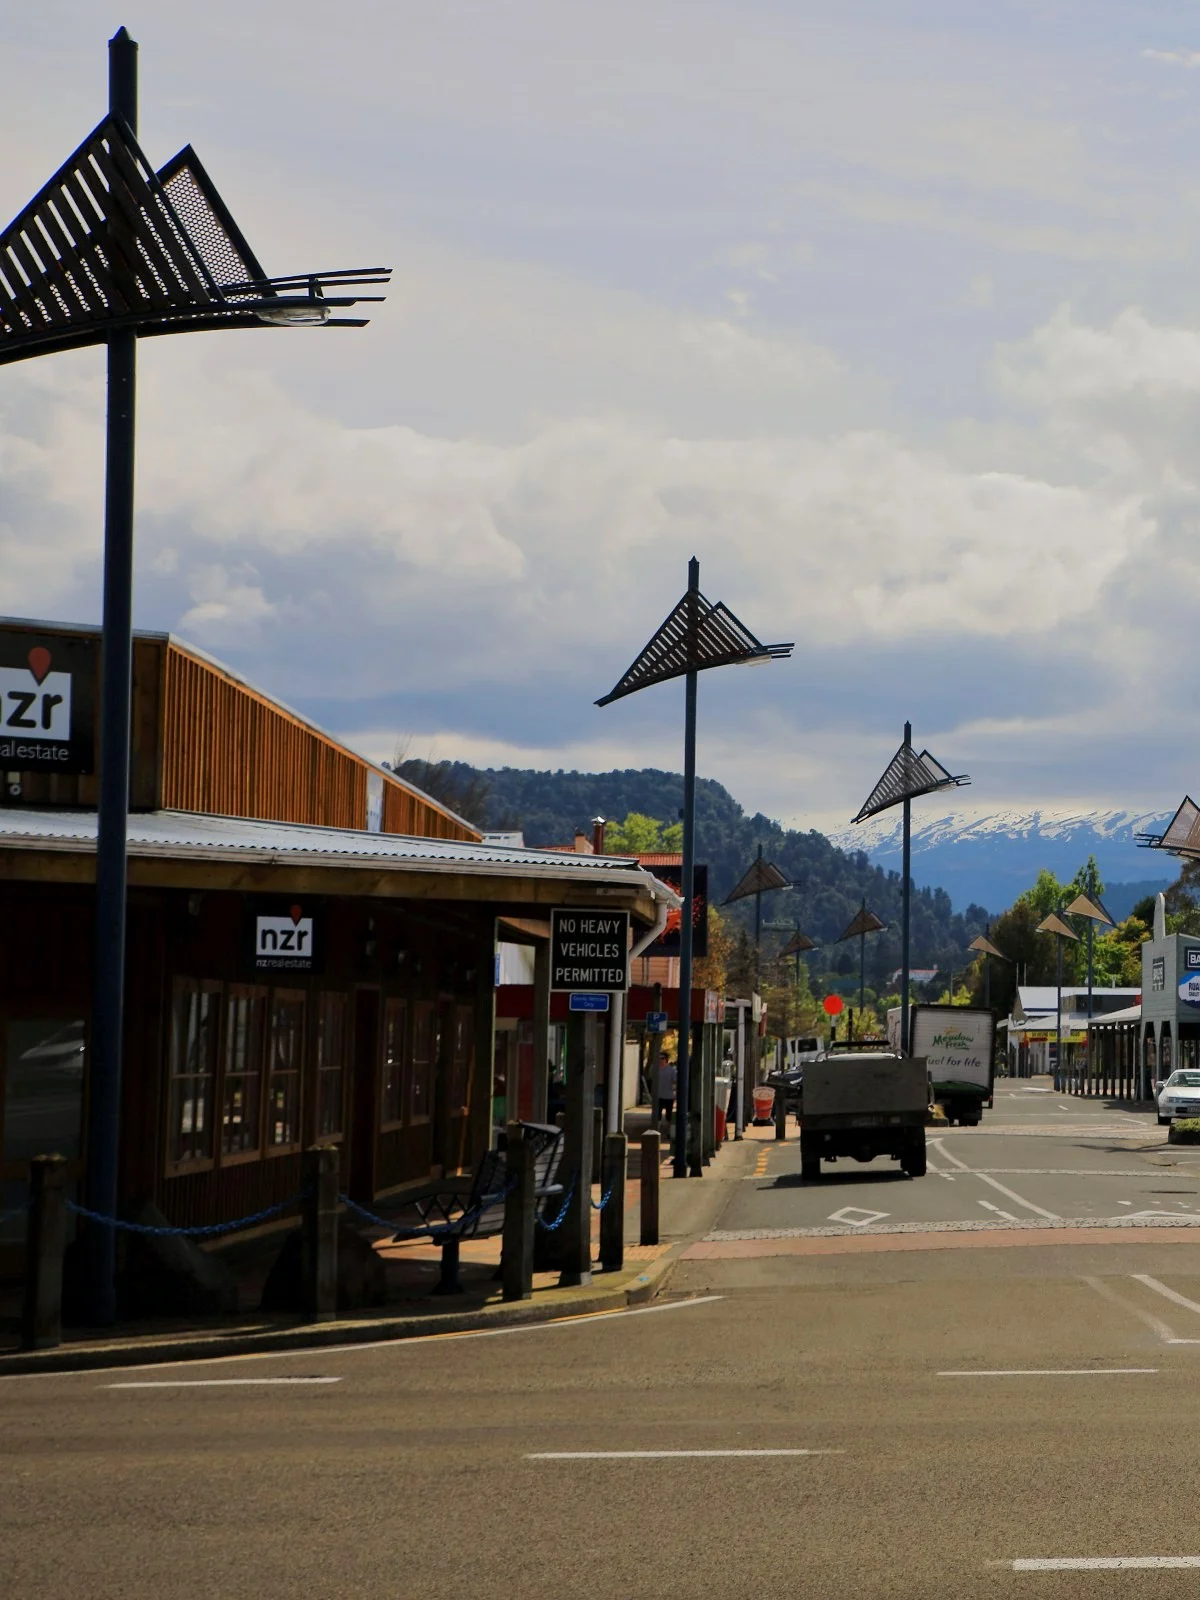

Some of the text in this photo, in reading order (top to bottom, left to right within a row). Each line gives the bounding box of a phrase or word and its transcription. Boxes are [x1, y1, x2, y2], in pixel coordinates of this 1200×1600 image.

[0, 690, 63, 730] zr
[559, 919, 620, 935] NO HEAVY
[261, 928, 309, 951] nzr
[560, 942, 619, 958] VEHICLES
[556, 967, 624, 983] PERMITTED
[932, 1032, 974, 1047] Meadow
[963, 1057, 981, 1067] life
